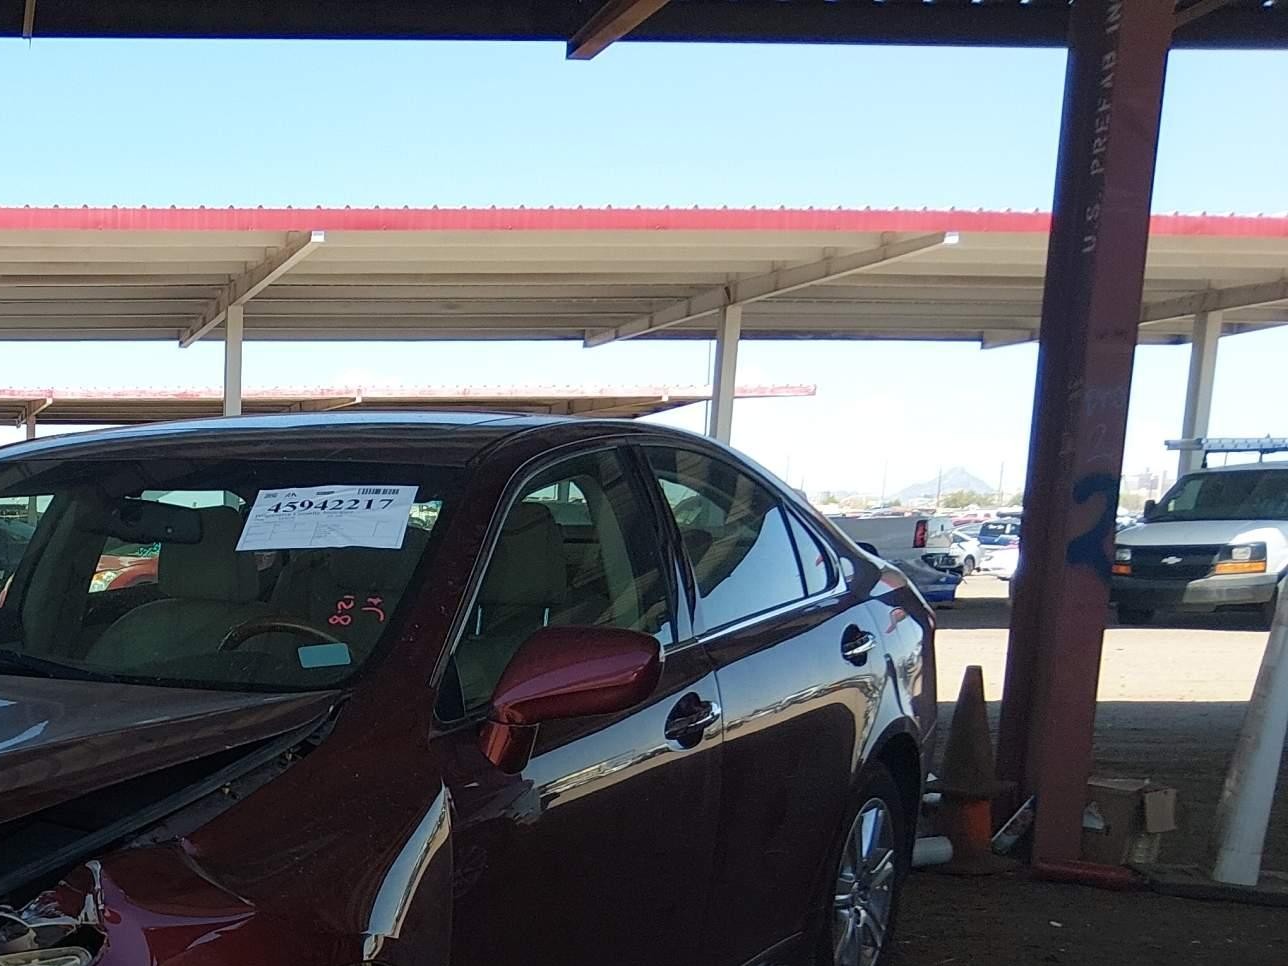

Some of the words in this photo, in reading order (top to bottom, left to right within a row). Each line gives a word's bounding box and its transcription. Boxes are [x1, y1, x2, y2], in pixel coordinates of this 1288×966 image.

[1090, 51, 1117, 176] PREFAB
[1104, 0, 1123, 35] IN
[267, 498, 394, 514] 45942217
[1067, 472, 1119, 577] 2
